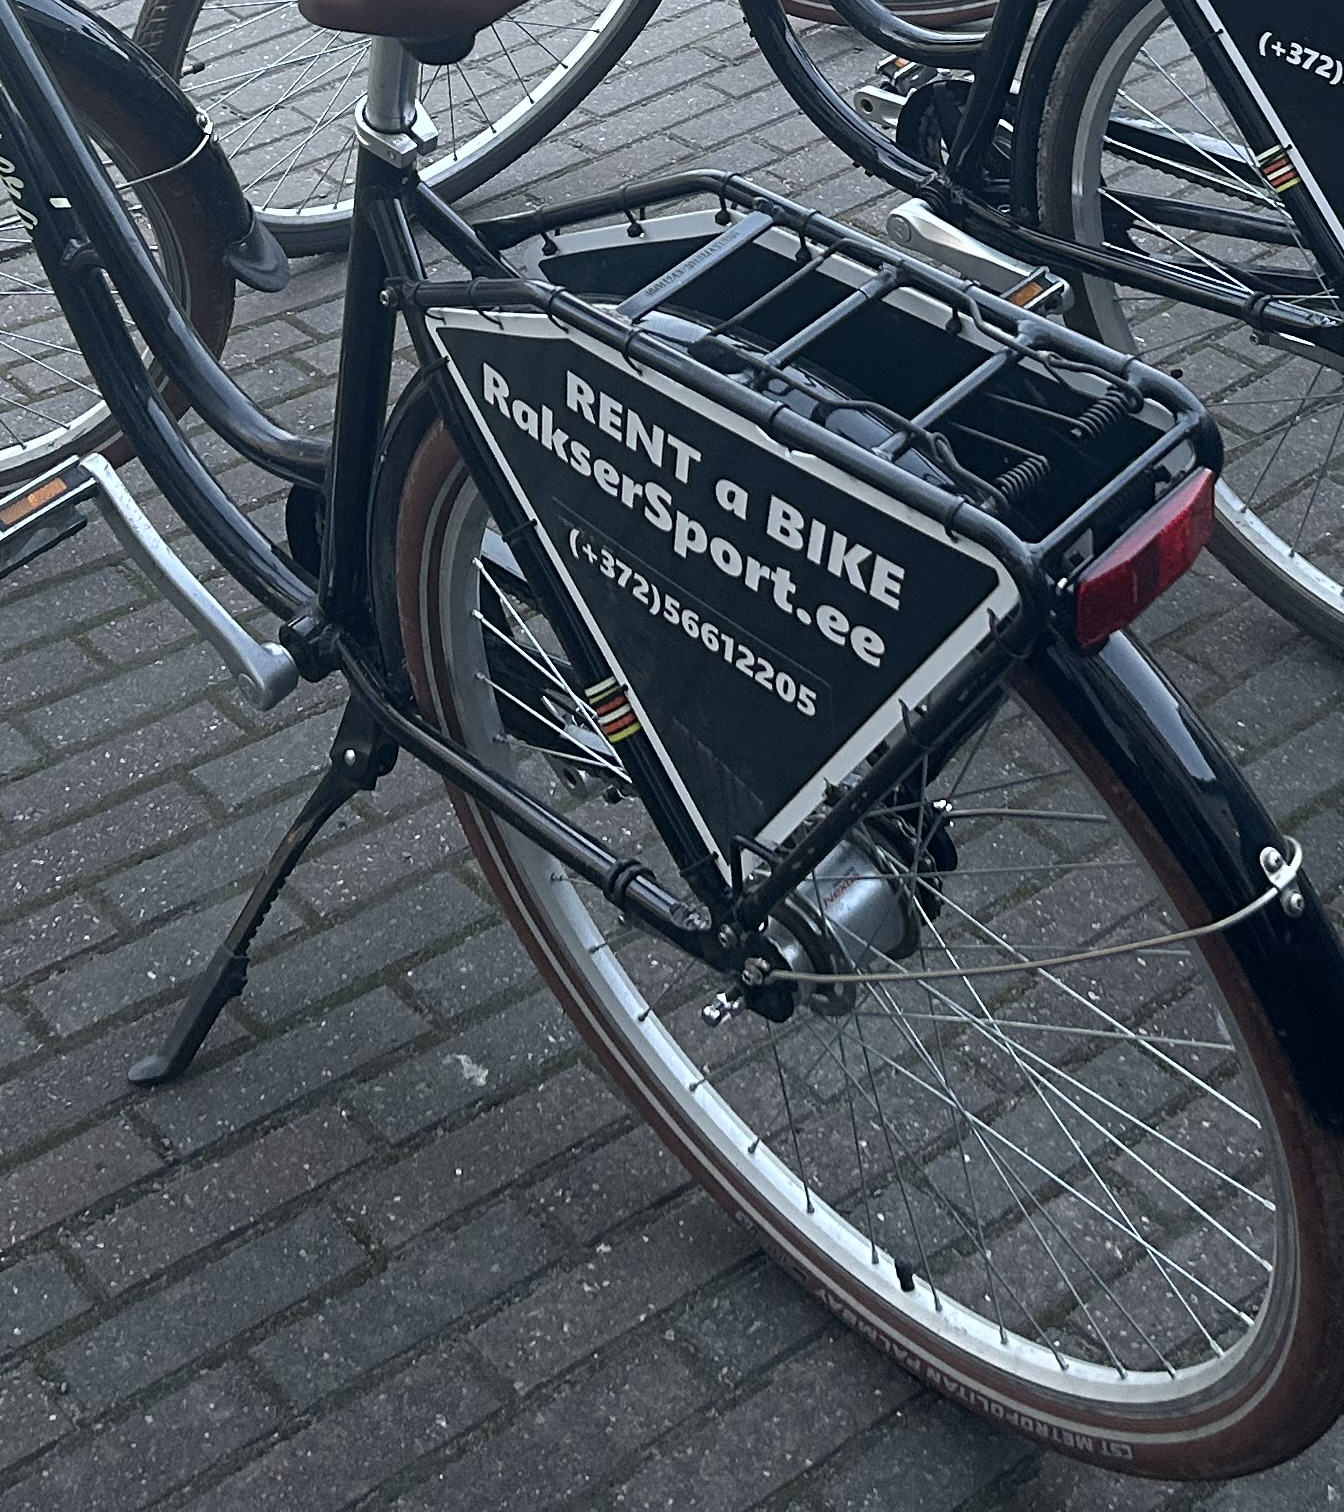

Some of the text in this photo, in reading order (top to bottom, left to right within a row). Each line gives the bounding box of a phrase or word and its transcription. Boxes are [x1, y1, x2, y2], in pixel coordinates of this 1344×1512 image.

[482, 362, 886, 668] RakserSport.ee
[565, 370, 905, 611] RENT a BIKE
[568, 528, 817, 718] (+372)56612205
